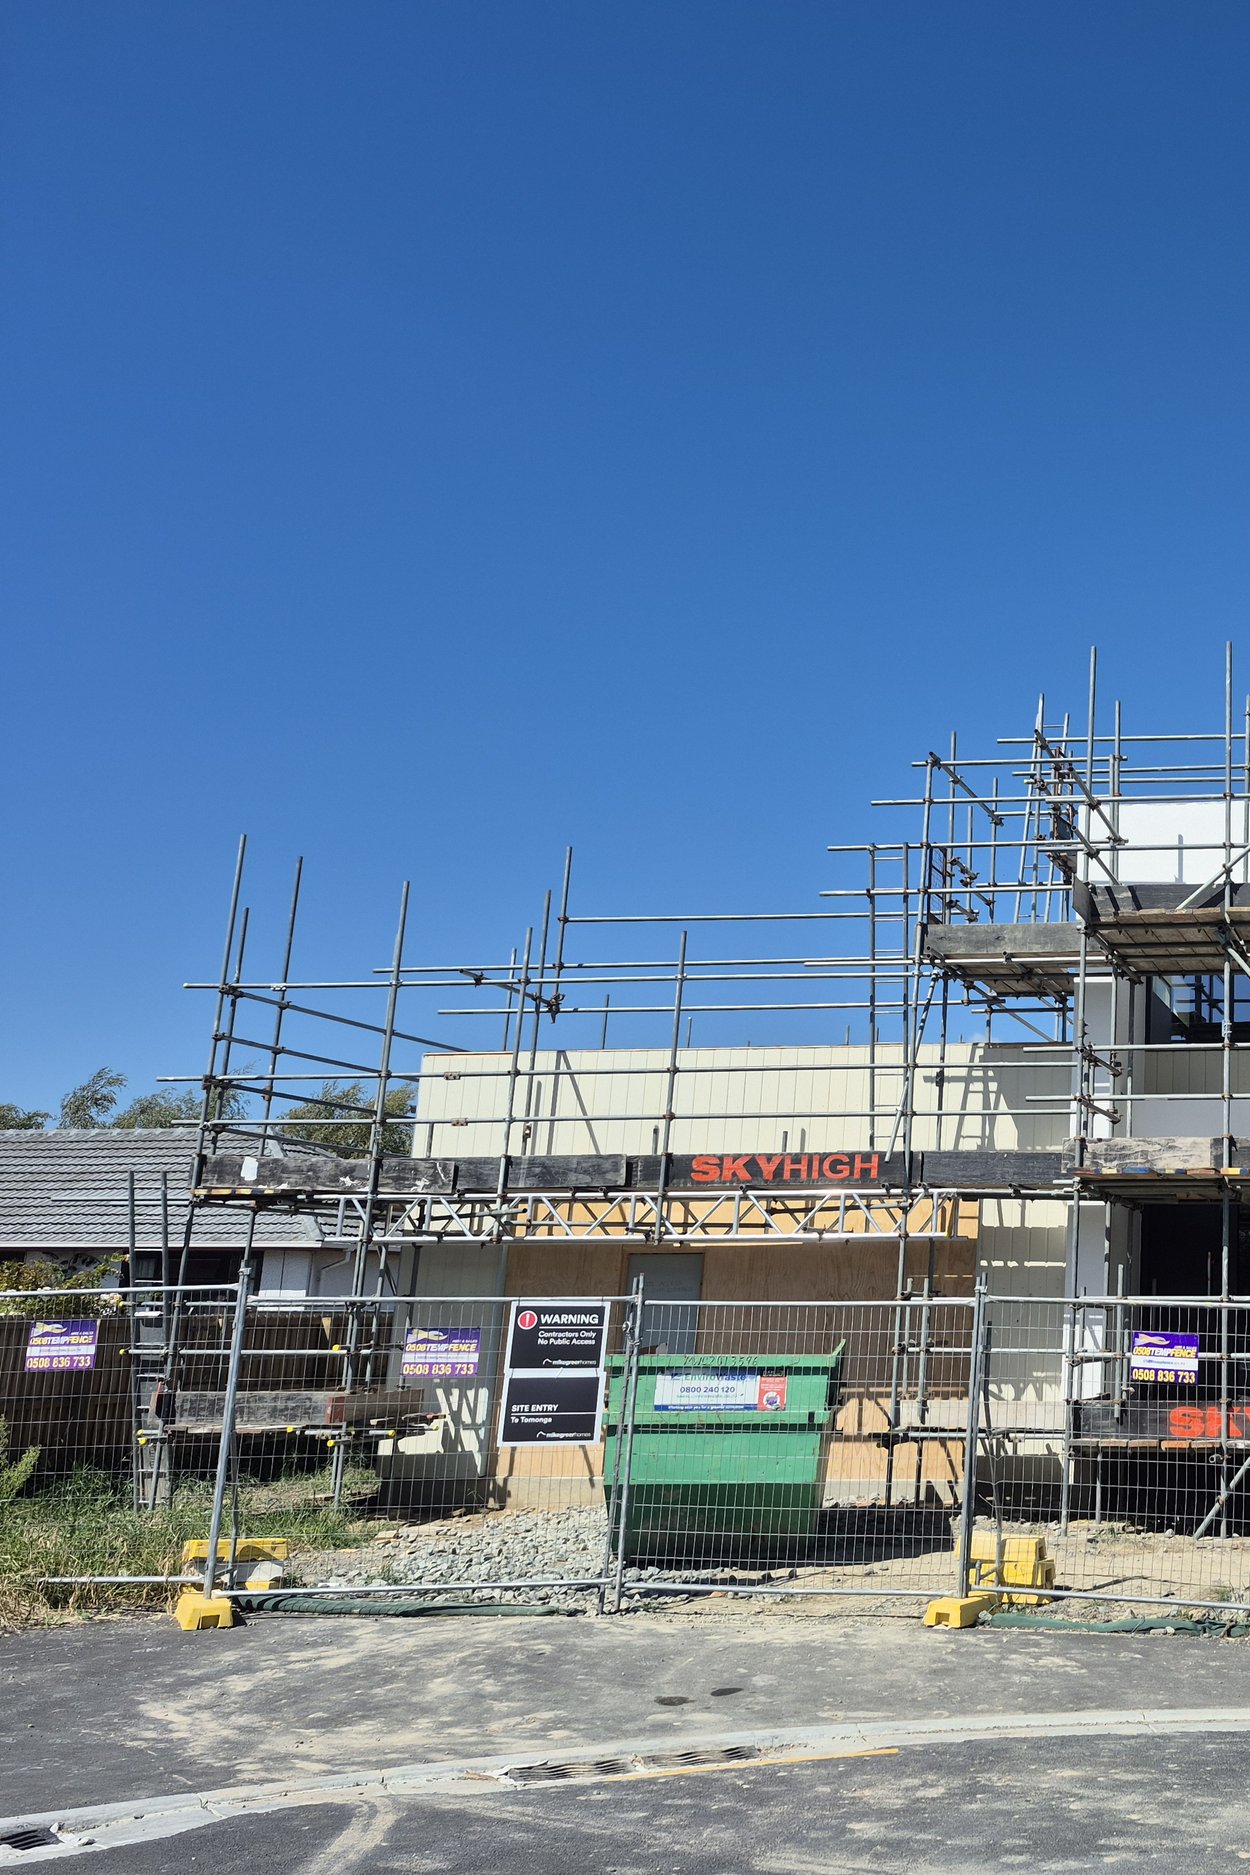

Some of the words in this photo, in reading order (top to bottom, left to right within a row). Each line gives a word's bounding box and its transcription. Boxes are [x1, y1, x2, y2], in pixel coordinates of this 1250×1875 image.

[690, 1154, 880, 1182] SKYHIGH
[540, 1314, 599, 1324] WARNING
[580, 1330, 596, 1338] Only
[406, 1344, 478, 1352] 0508TEMPFENCE
[1133, 1346, 1197, 1358] 0508TEMPFENCE
[26, 1358, 50, 1368] 0508
[52, 1357, 70, 1368] 836
[73, 1356, 91, 1368] 733
[402, 1364, 430, 1374] 0508
[432, 1364, 452, 1374] 836
[454, 1364, 474, 1374] 733
[684, 1372, 746, 1382] EnviroWaste
[1132, 1368, 1155, 1380] 0508
[1157, 1370, 1175, 1382] 836
[1178, 1371, 1196, 1383] 733
[680, 1386, 702, 1394] 0800
[704, 1386, 720, 1394] 240
[512, 1404, 530, 1412] SITE
[531, 1404, 558, 1412] ENTRY
[520, 1416, 552, 1424] Tomonga
